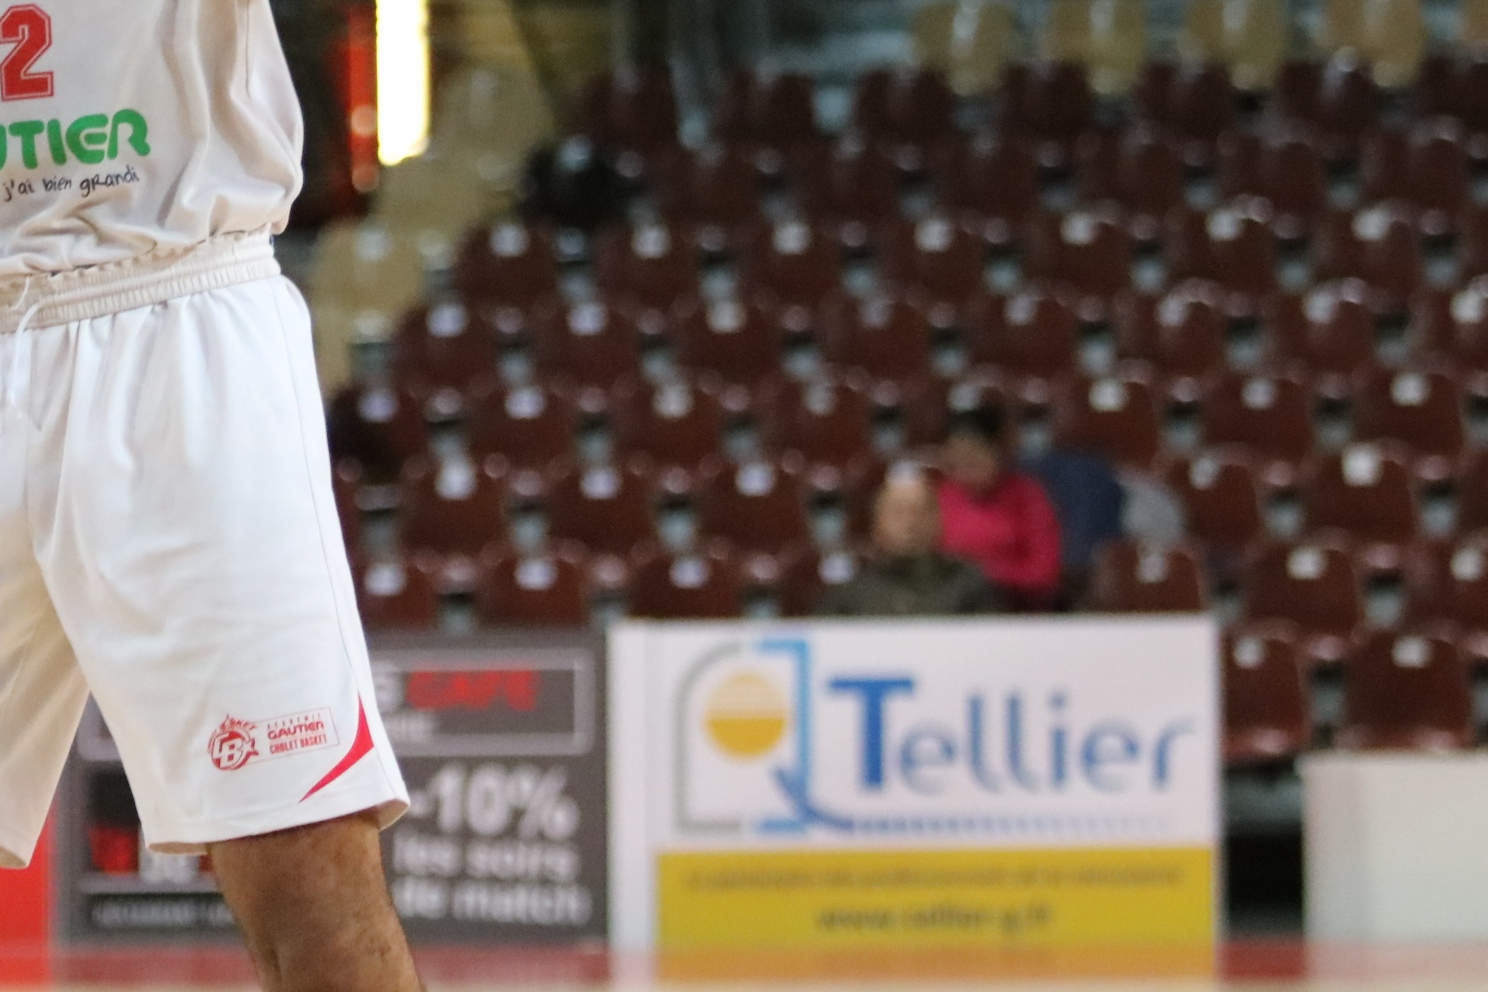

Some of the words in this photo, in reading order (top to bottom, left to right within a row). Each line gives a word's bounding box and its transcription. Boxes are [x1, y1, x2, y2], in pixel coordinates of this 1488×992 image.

[2, 178, 34, 202] j'ai
[44, 174, 72, 192] bien
[267, 721, 325, 740] GAUTIER
[826, 675, 1197, 798] Tellier
[407, 762, 581, 841] -10%
